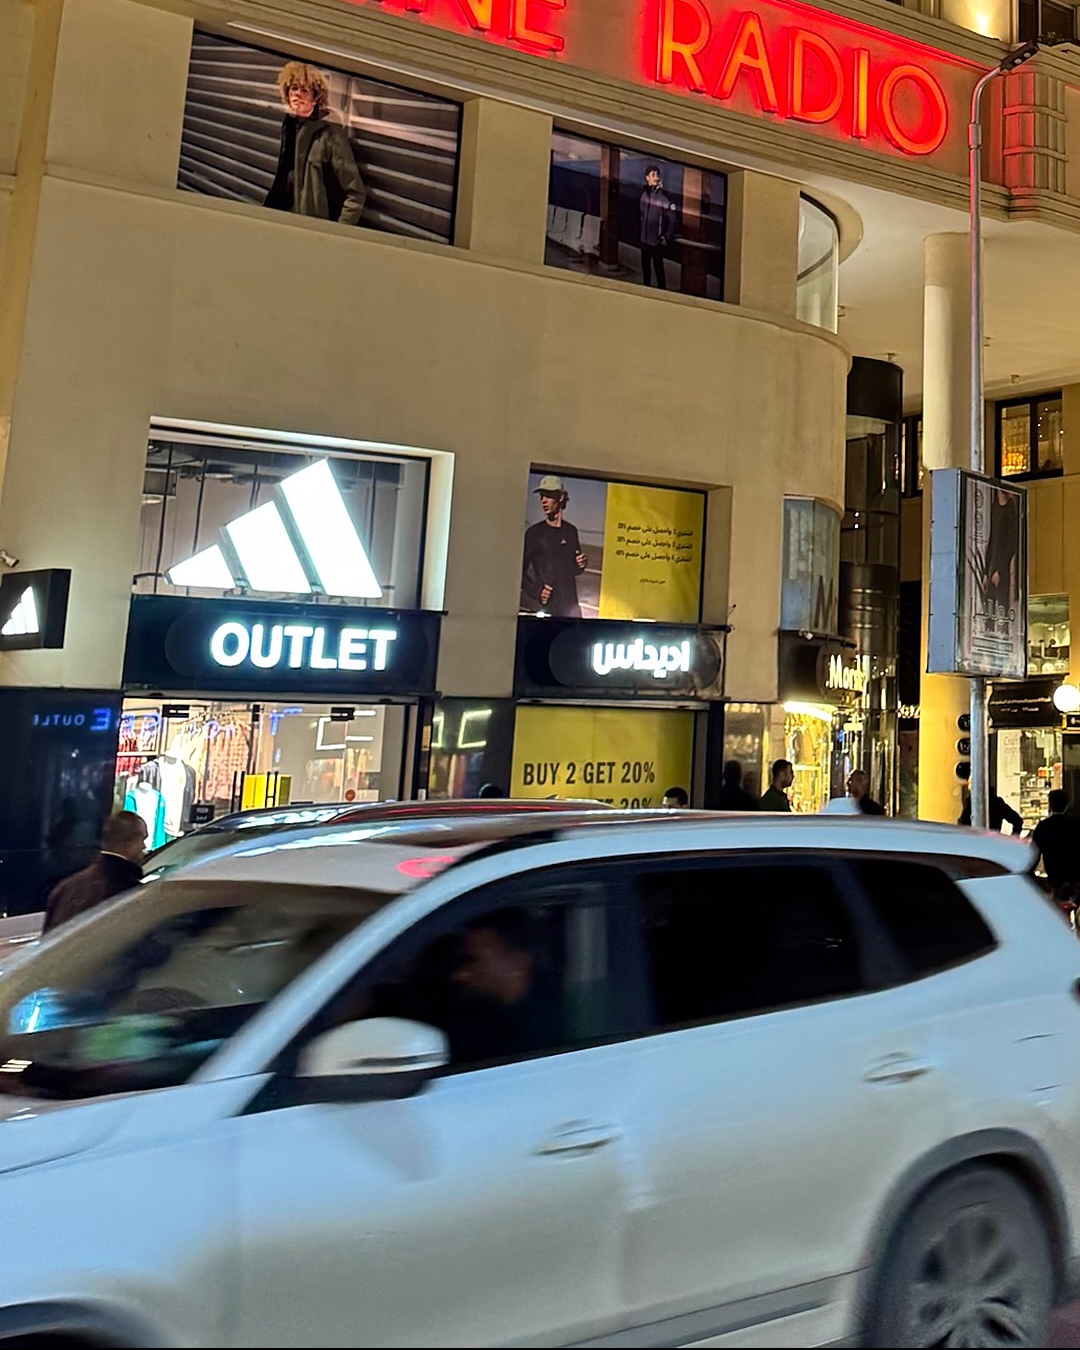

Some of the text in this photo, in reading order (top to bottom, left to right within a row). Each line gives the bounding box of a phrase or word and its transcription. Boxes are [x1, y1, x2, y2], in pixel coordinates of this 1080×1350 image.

[209, 620, 397, 672] OUTLET
[593, 637, 691, 679] اديداس
[523, 761, 655, 786] BUY 2 GET 20%
